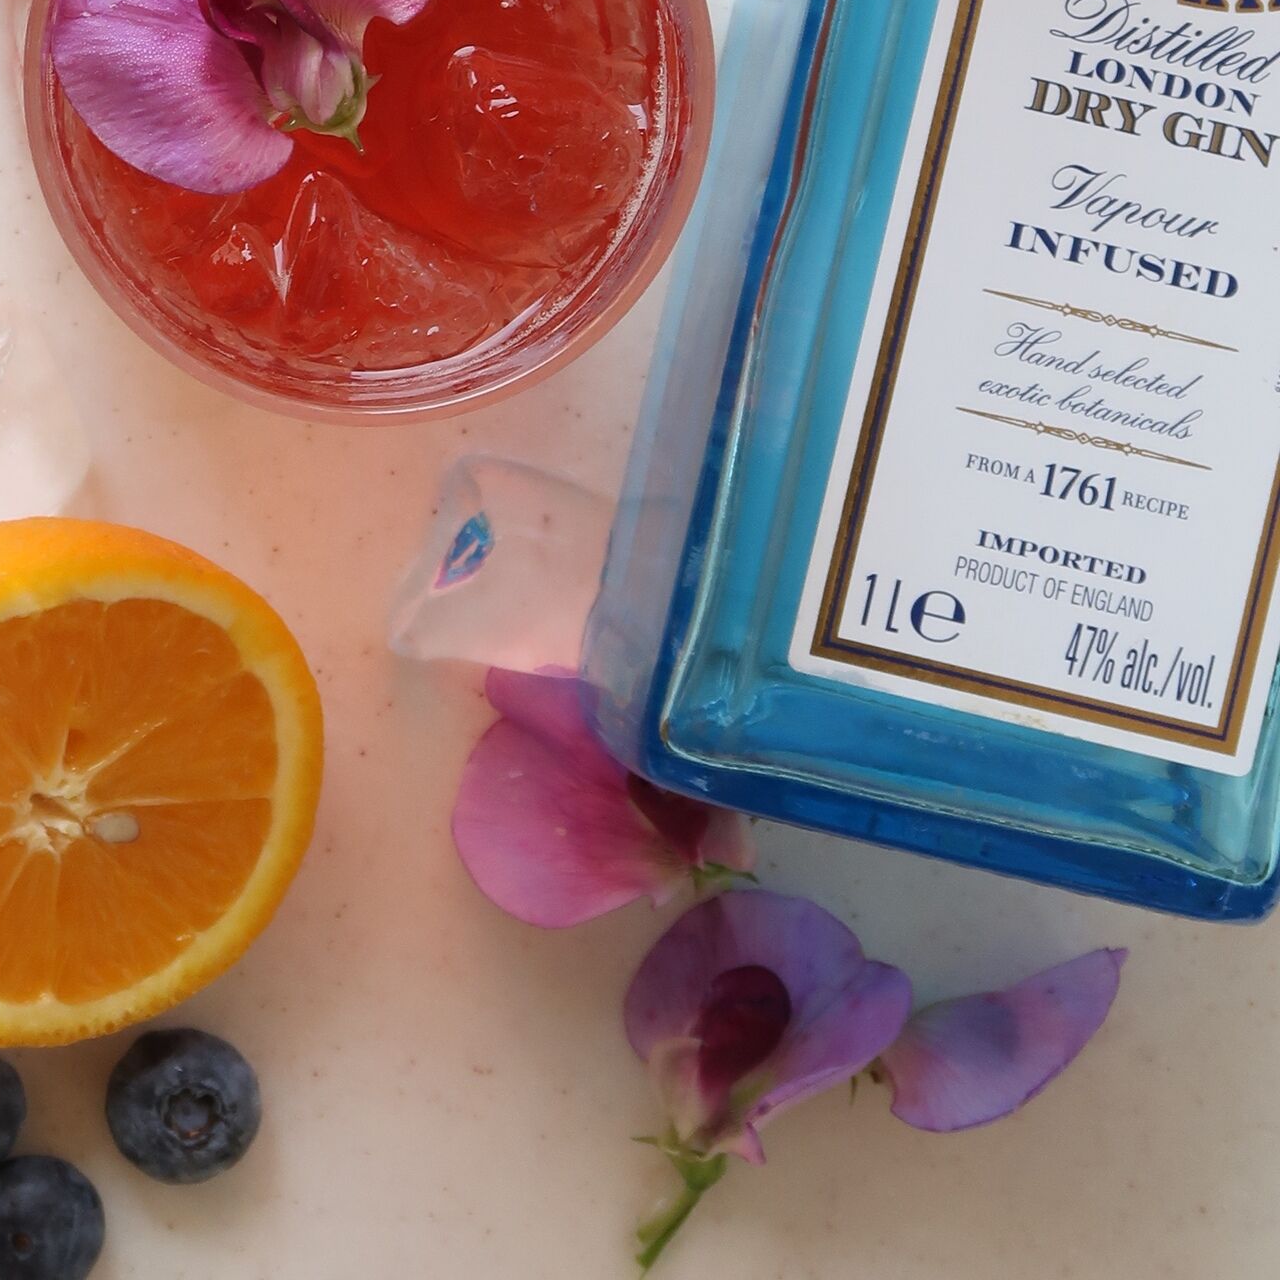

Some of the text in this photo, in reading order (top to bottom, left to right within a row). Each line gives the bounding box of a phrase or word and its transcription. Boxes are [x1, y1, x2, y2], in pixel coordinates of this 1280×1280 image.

[1065, 50, 1259, 116] LONDON
[1024, 77, 1280, 167] DRY GIN
[1050, 164, 1219, 238] Vapour
[1005, 222, 1238, 298] INFUSED
[994, 322, 1204, 399] Hand selected
[978, 380, 1203, 439] exotic botanicals
[966, 453, 1189, 520] FROM A 1761 RECIPE
[954, 555, 1154, 622] PRODUCT OF ENGLAND
[977, 530, 1146, 584] IMPORTED
[1065, 622, 1216, 709] 47% alc./vol.
